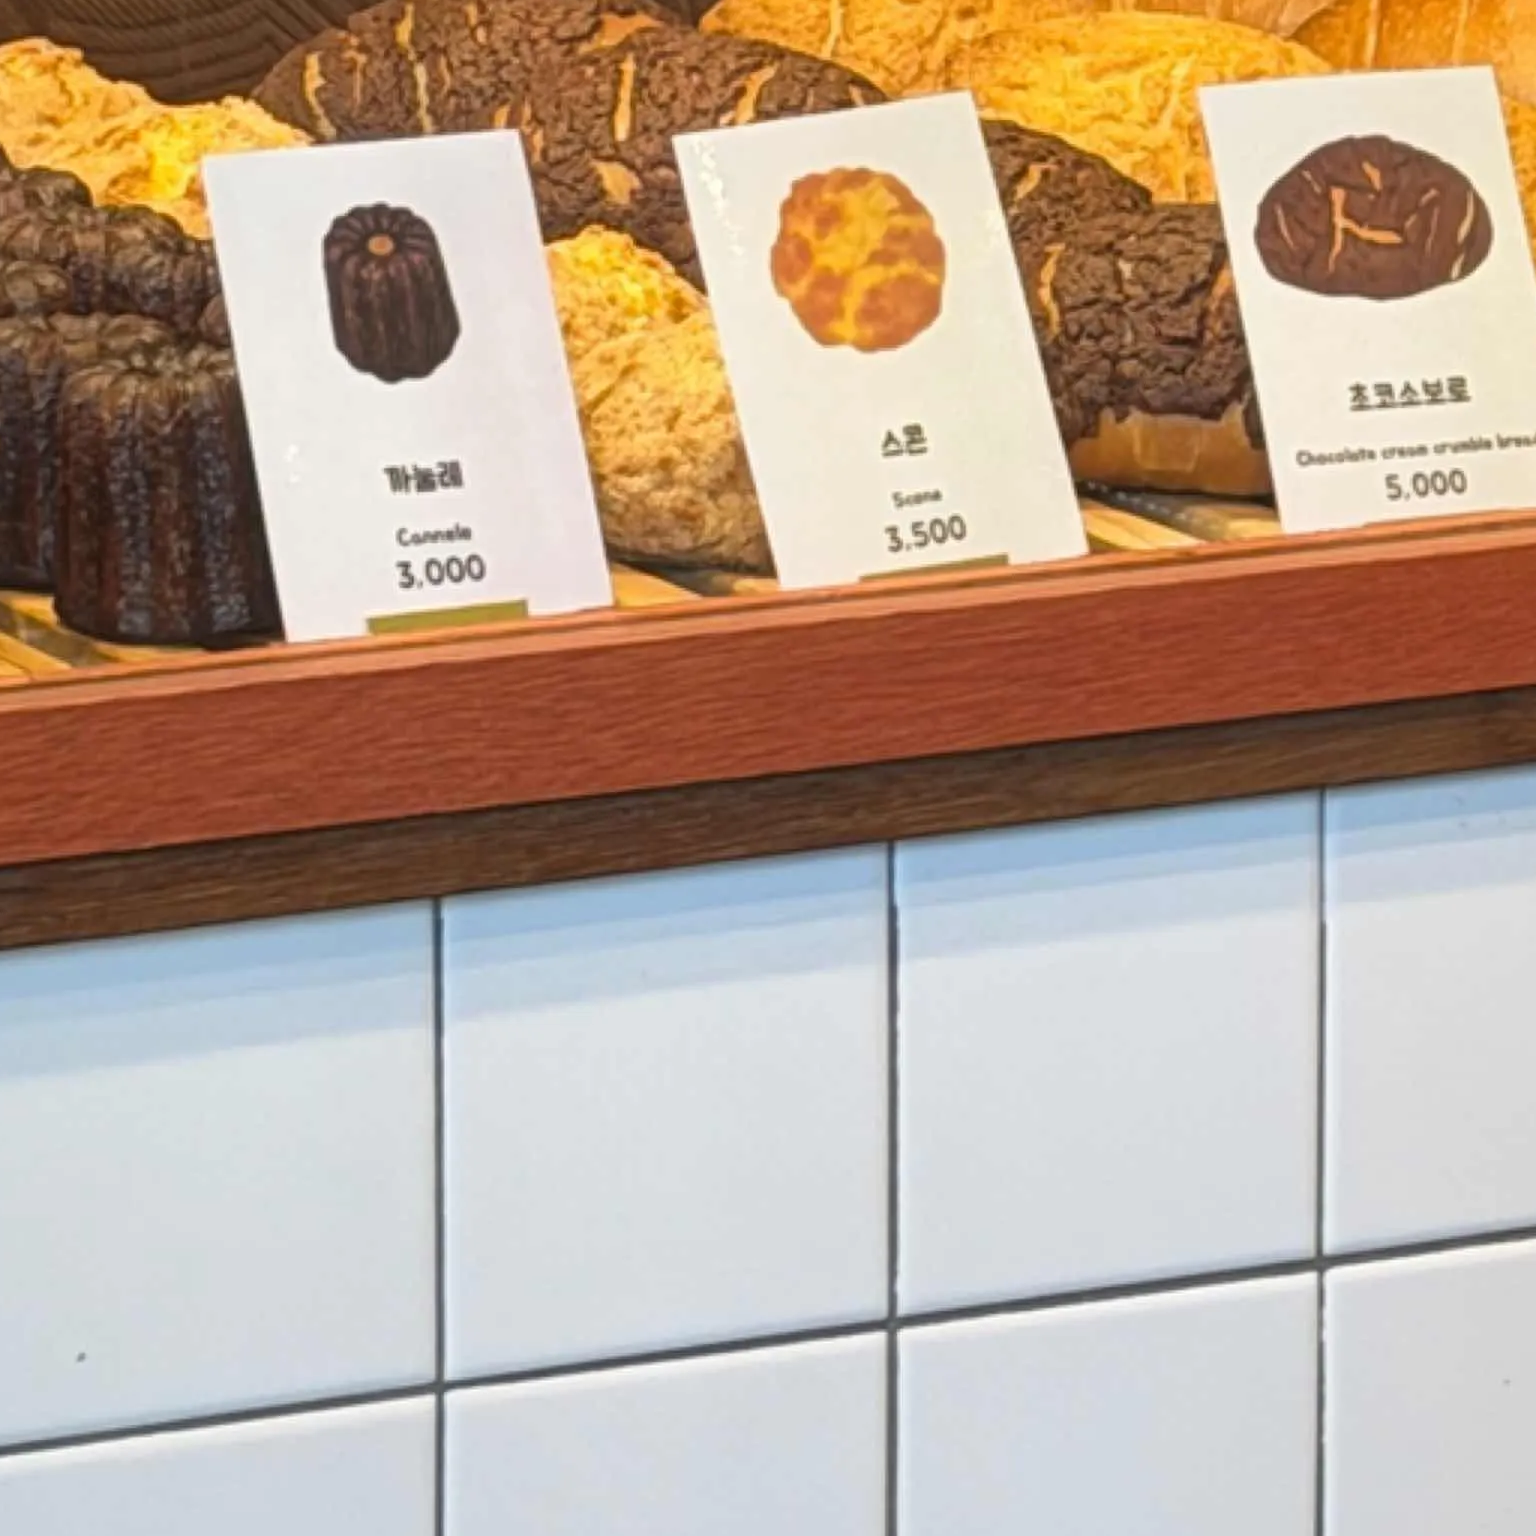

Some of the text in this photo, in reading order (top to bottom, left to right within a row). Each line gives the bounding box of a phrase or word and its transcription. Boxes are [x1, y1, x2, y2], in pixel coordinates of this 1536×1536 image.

[1349, 375, 1471, 411] 초코소보로
[882, 423, 927, 458] 스콘
[1296, 445, 1376, 467] Chocolate
[1381, 444, 1428, 460] cream
[1433, 436, 1493, 455] crumble
[892, 489, 943, 509] Scone
[1385, 468, 1468, 501] 5,000
[884, 514, 967, 553] 3,500
[395, 553, 486, 589] 3,000
